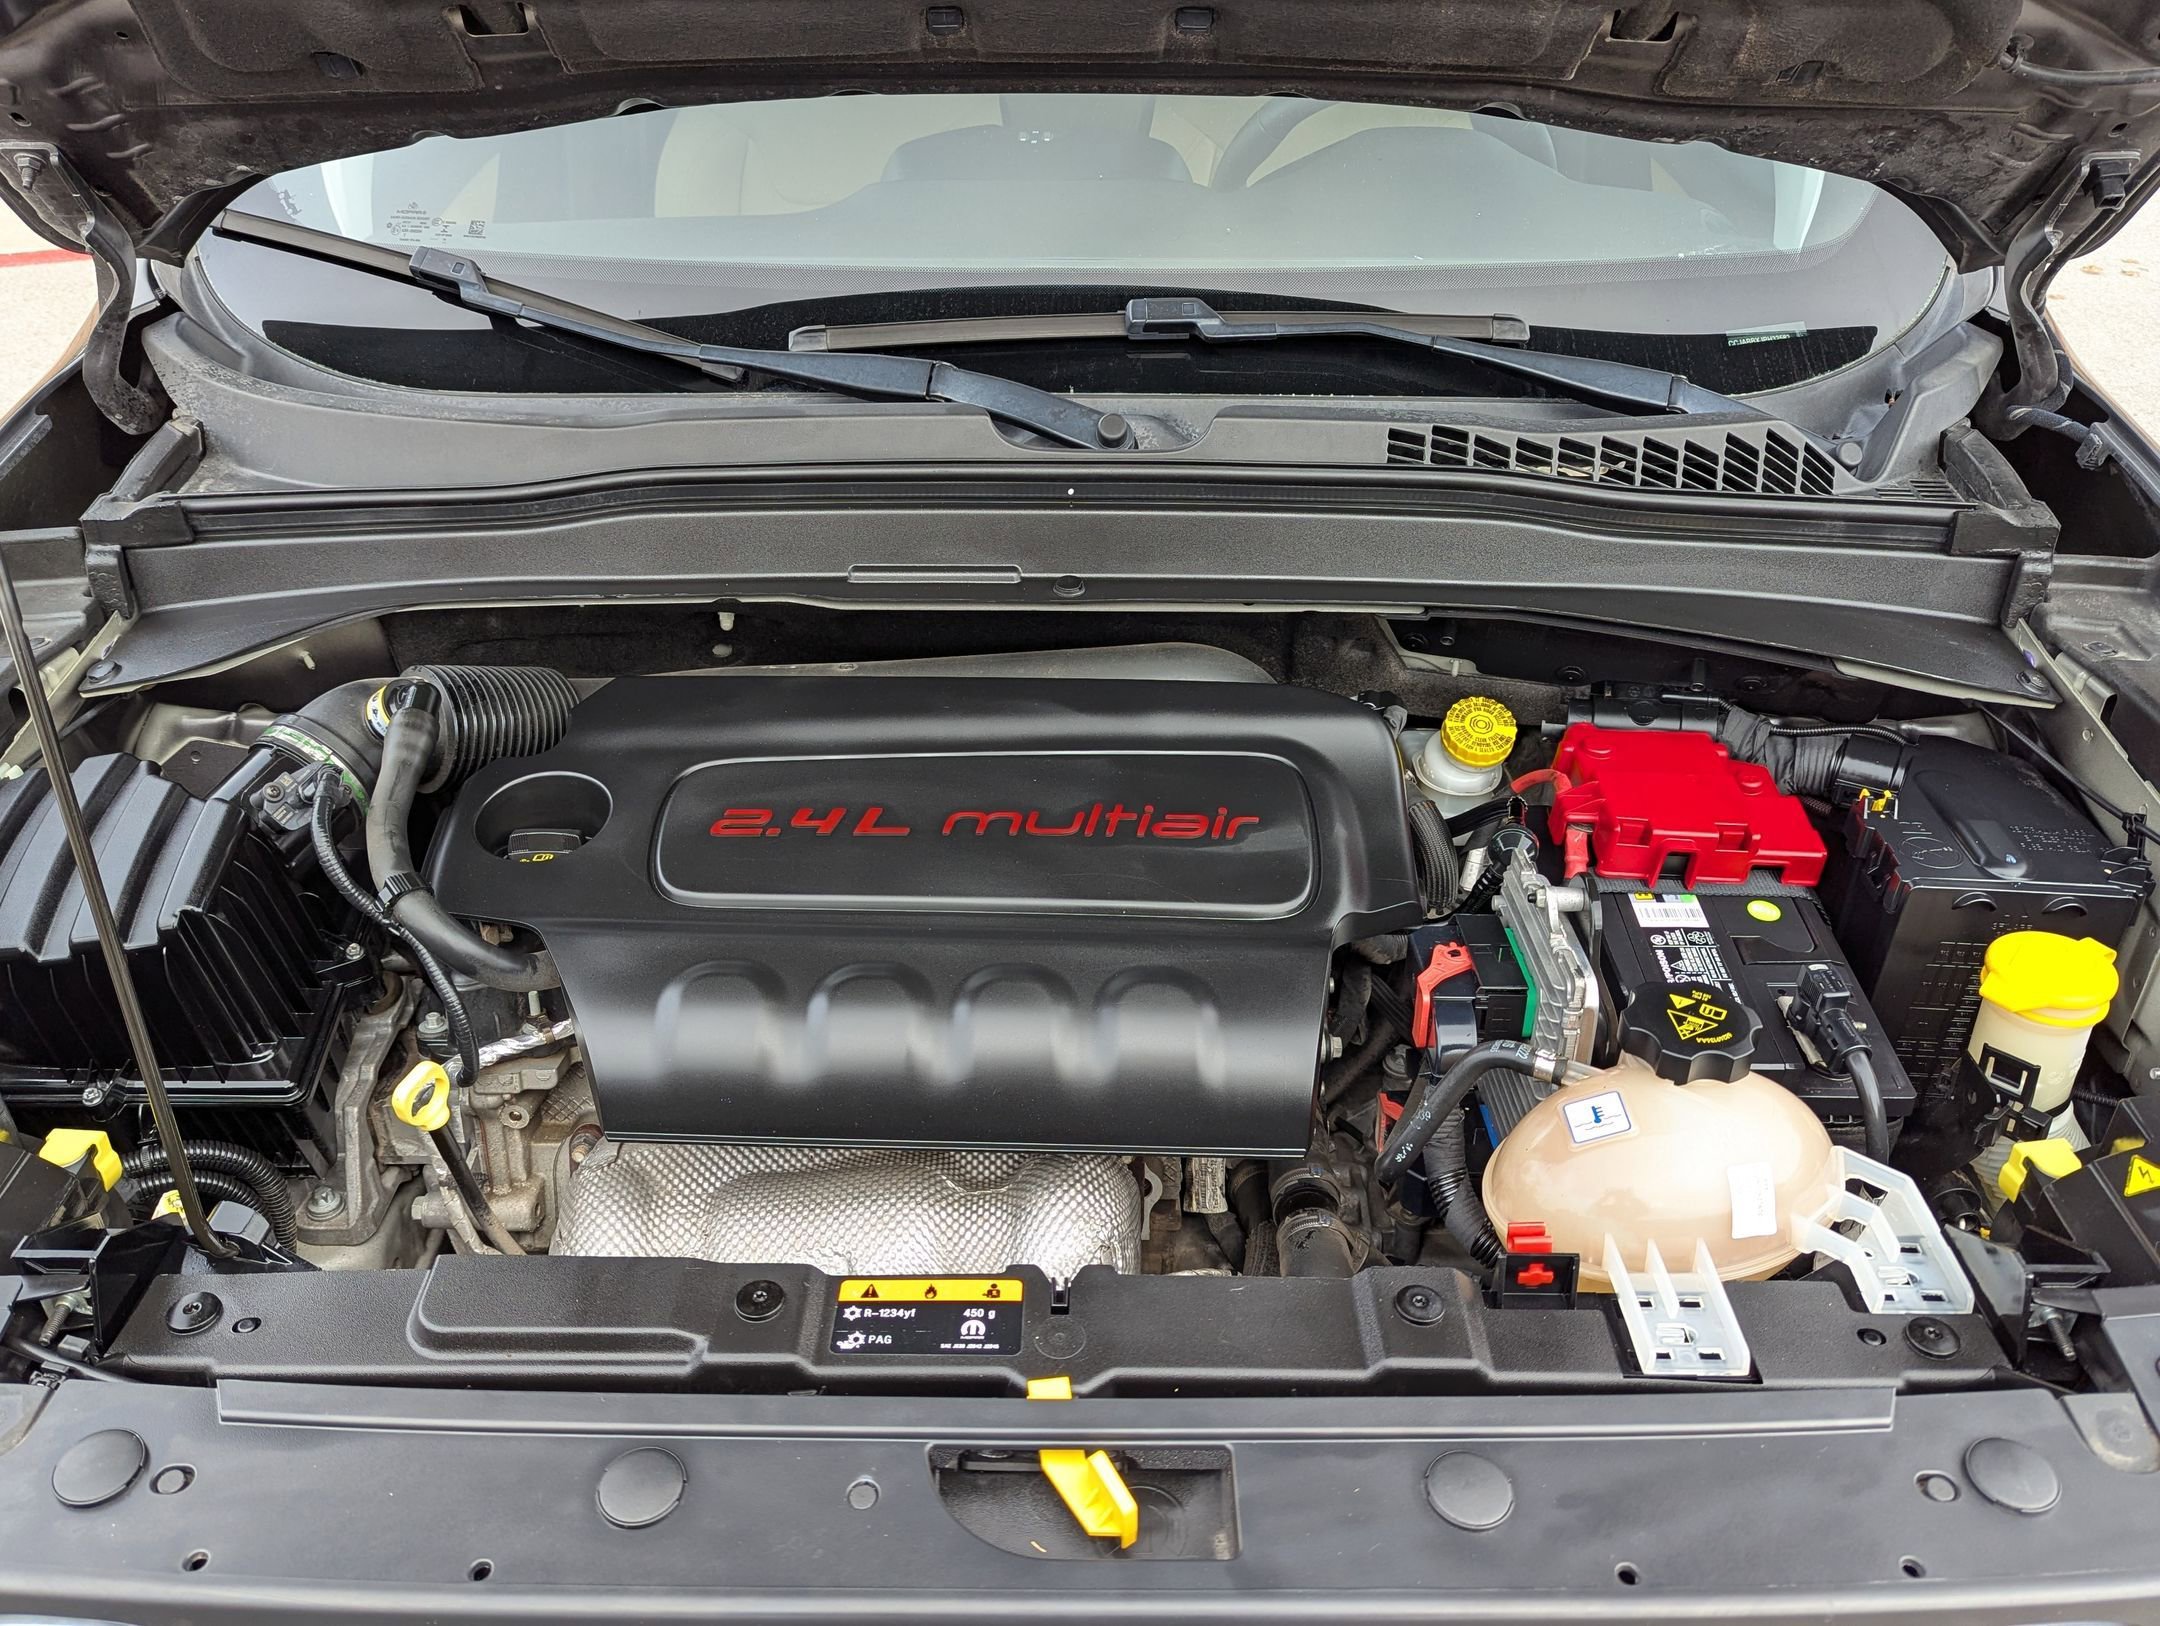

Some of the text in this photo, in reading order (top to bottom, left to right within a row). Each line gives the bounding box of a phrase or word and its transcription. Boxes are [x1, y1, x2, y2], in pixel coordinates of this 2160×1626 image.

[942, 803, 1260, 840] multiair
[863, 1307, 996, 1320] R-1234yf 450 g
[868, 1334, 892, 1345] PAG
